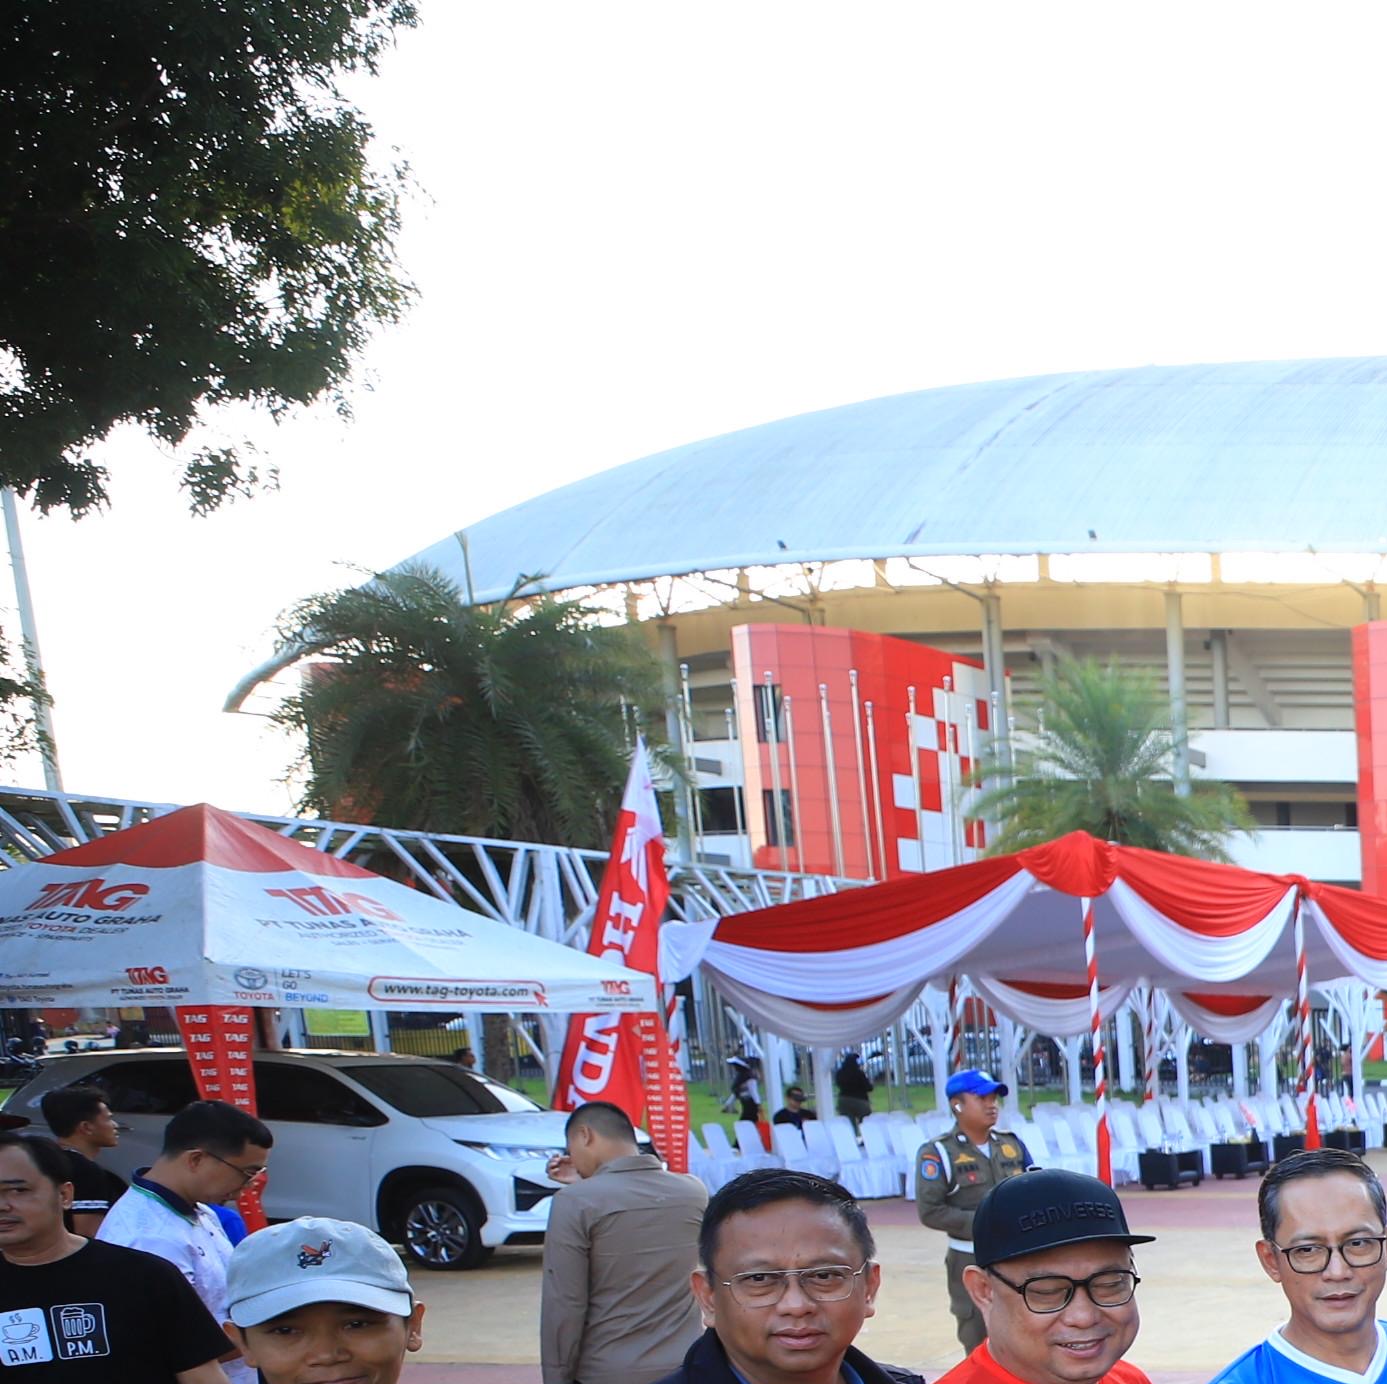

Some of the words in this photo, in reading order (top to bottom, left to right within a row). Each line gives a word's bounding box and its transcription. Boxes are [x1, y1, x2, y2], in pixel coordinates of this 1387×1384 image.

[34, 911, 91, 924] AUTO
[94, 915, 163, 925] GRAHA
[284, 920, 358, 930] TUNAS
[281, 968, 311, 979] LET'S
[282, 981, 297, 990] GO
[384, 983, 529, 1000] www.tag-toyota.com
[233, 991, 275, 1001] TOYOTA
[285, 992, 328, 1003] BEYOND
[1018, 1202, 1116, 1232] CONVERSE
[66, 1340, 100, 1356] P.M.
[7, 1346, 43, 1363] A.M.
